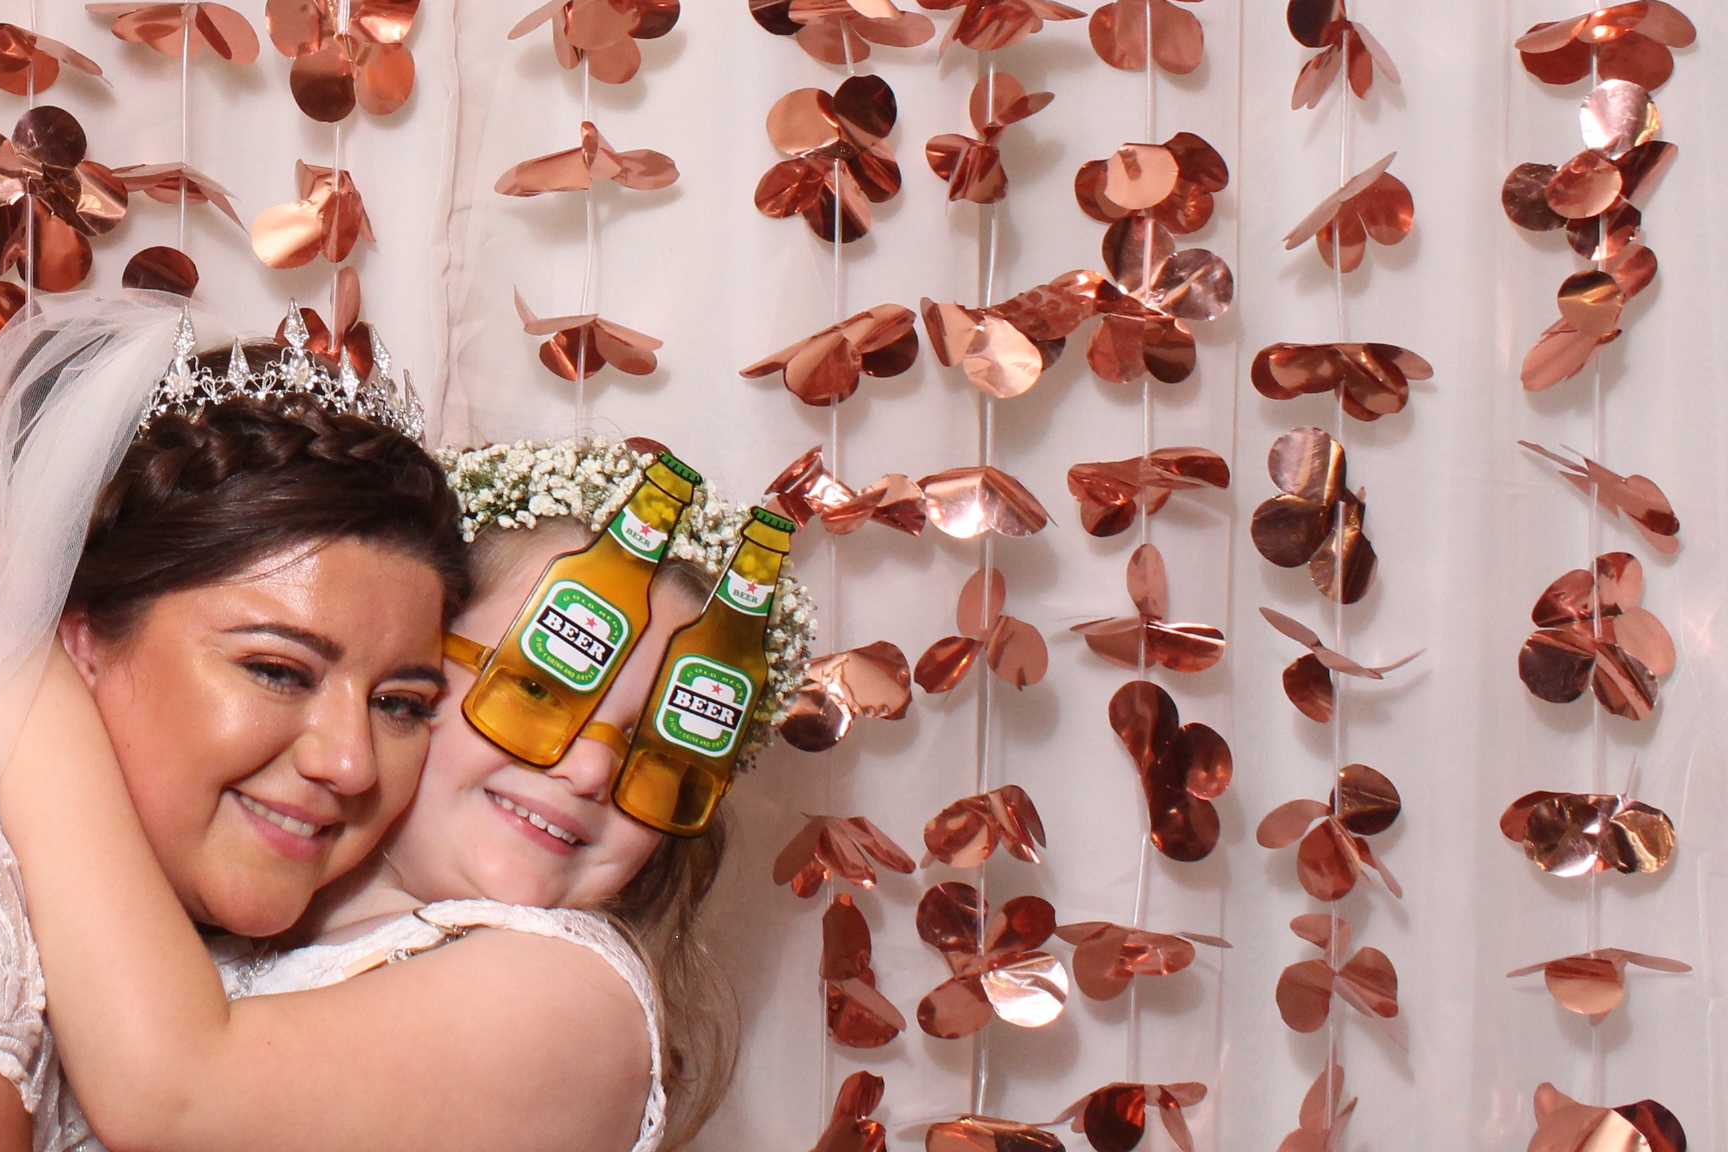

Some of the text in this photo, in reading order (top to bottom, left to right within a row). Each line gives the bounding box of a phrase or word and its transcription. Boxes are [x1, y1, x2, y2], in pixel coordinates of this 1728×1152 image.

[625, 527, 651, 548] BEER
[732, 589, 758, 604] BEER
[562, 594, 619, 641] GOLD MEDAL
[542, 610, 606, 662] BEER
[546, 654, 564, 671] DRINK
[563, 667, 576, 679] AND
[576, 671, 596, 681] DRIVE
[672, 689, 735, 726] BEER
[699, 739, 711, 748] AND
